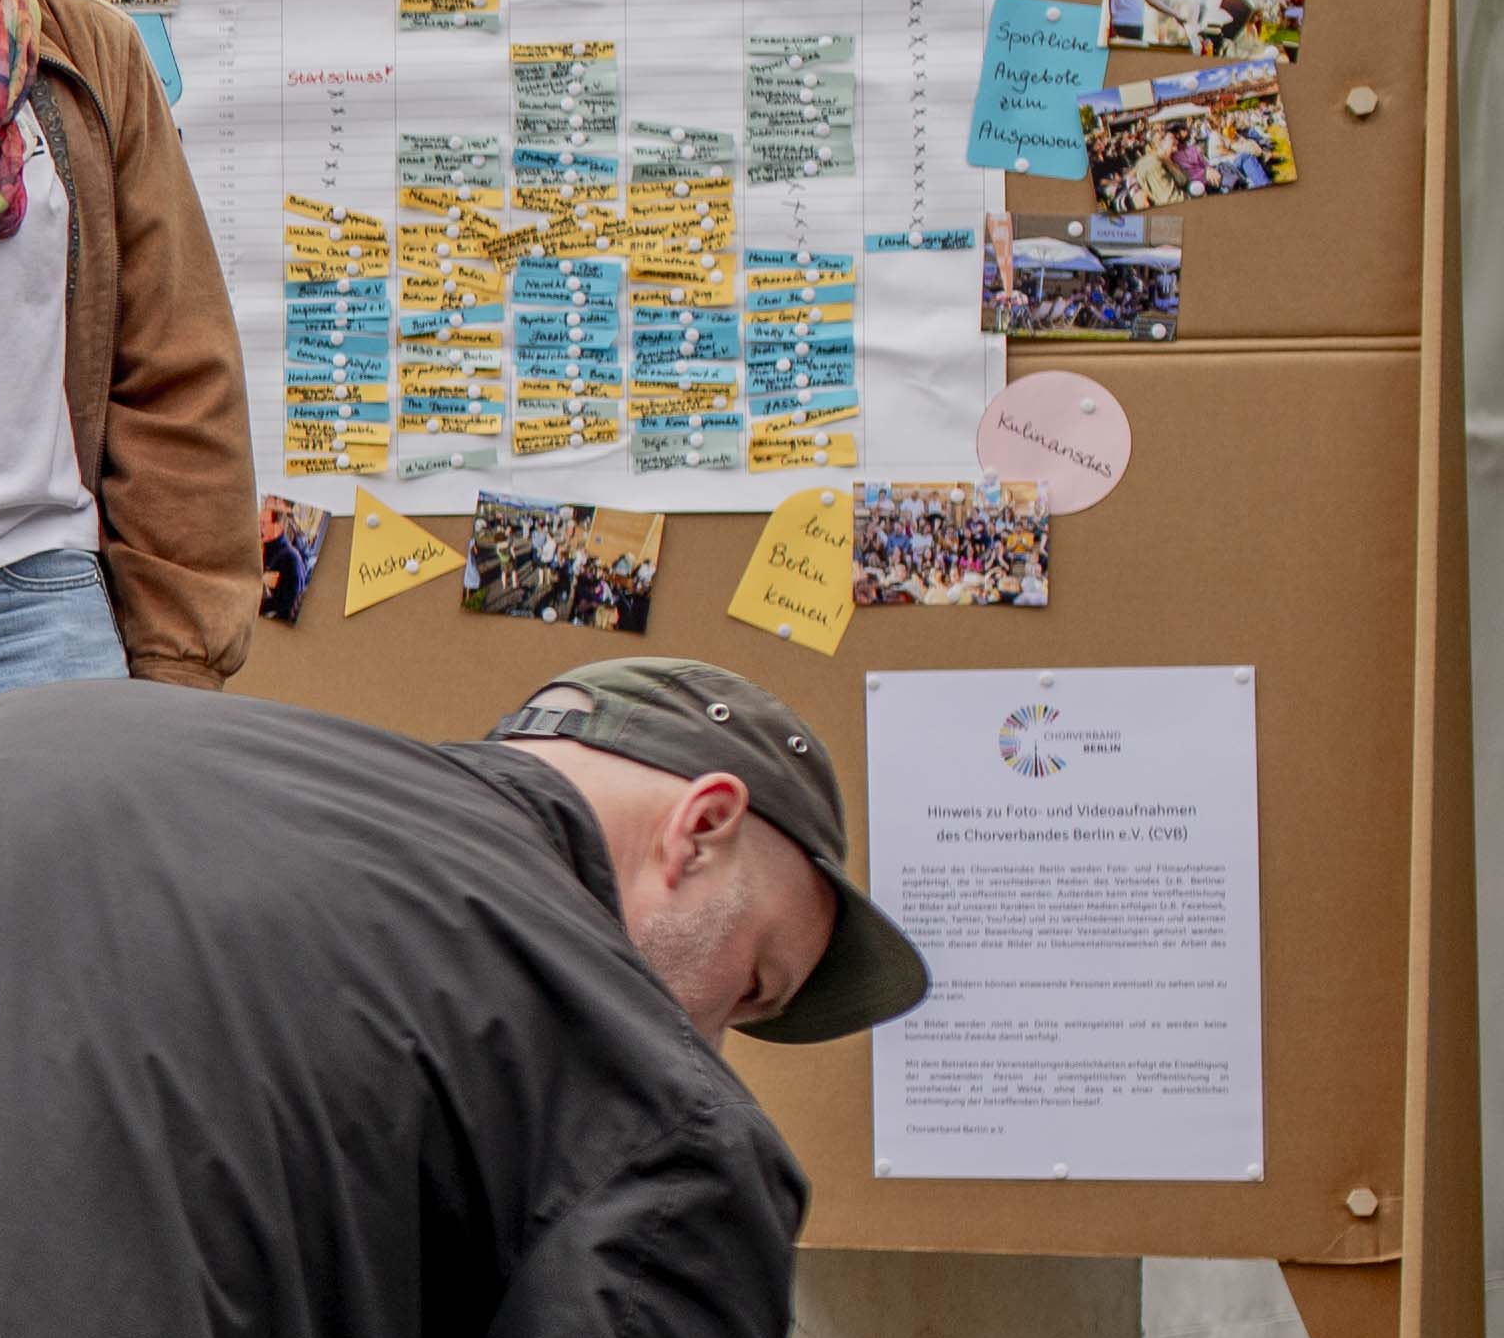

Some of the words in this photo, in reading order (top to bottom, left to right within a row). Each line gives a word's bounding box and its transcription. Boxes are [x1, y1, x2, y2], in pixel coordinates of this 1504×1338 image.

[996, 21, 1094, 54] Sportliche
[994, 61, 1082, 94] Angebote
[999, 97, 1047, 111] zum
[768, 541, 828, 587] Berlin
[1043, 729, 1123, 741] CHORVERBAND
[1083, 742, 1121, 754] BERLIN
[923, 803, 982, 821] Hinweis
[983, 803, 1002, 821] zu
[1003, 803, 1045, 821] Foto-
[1046, 803, 1073, 821] und
[1074, 803, 1200, 820] Videoaufnahmen
[936, 826, 963, 844] des
[964, 826, 1069, 844] Chorverbandes
[1070, 826, 1115, 844] Berlin
[1116, 826, 1144, 844] e.V.
[1145, 826, 1191, 844] (CVB)
